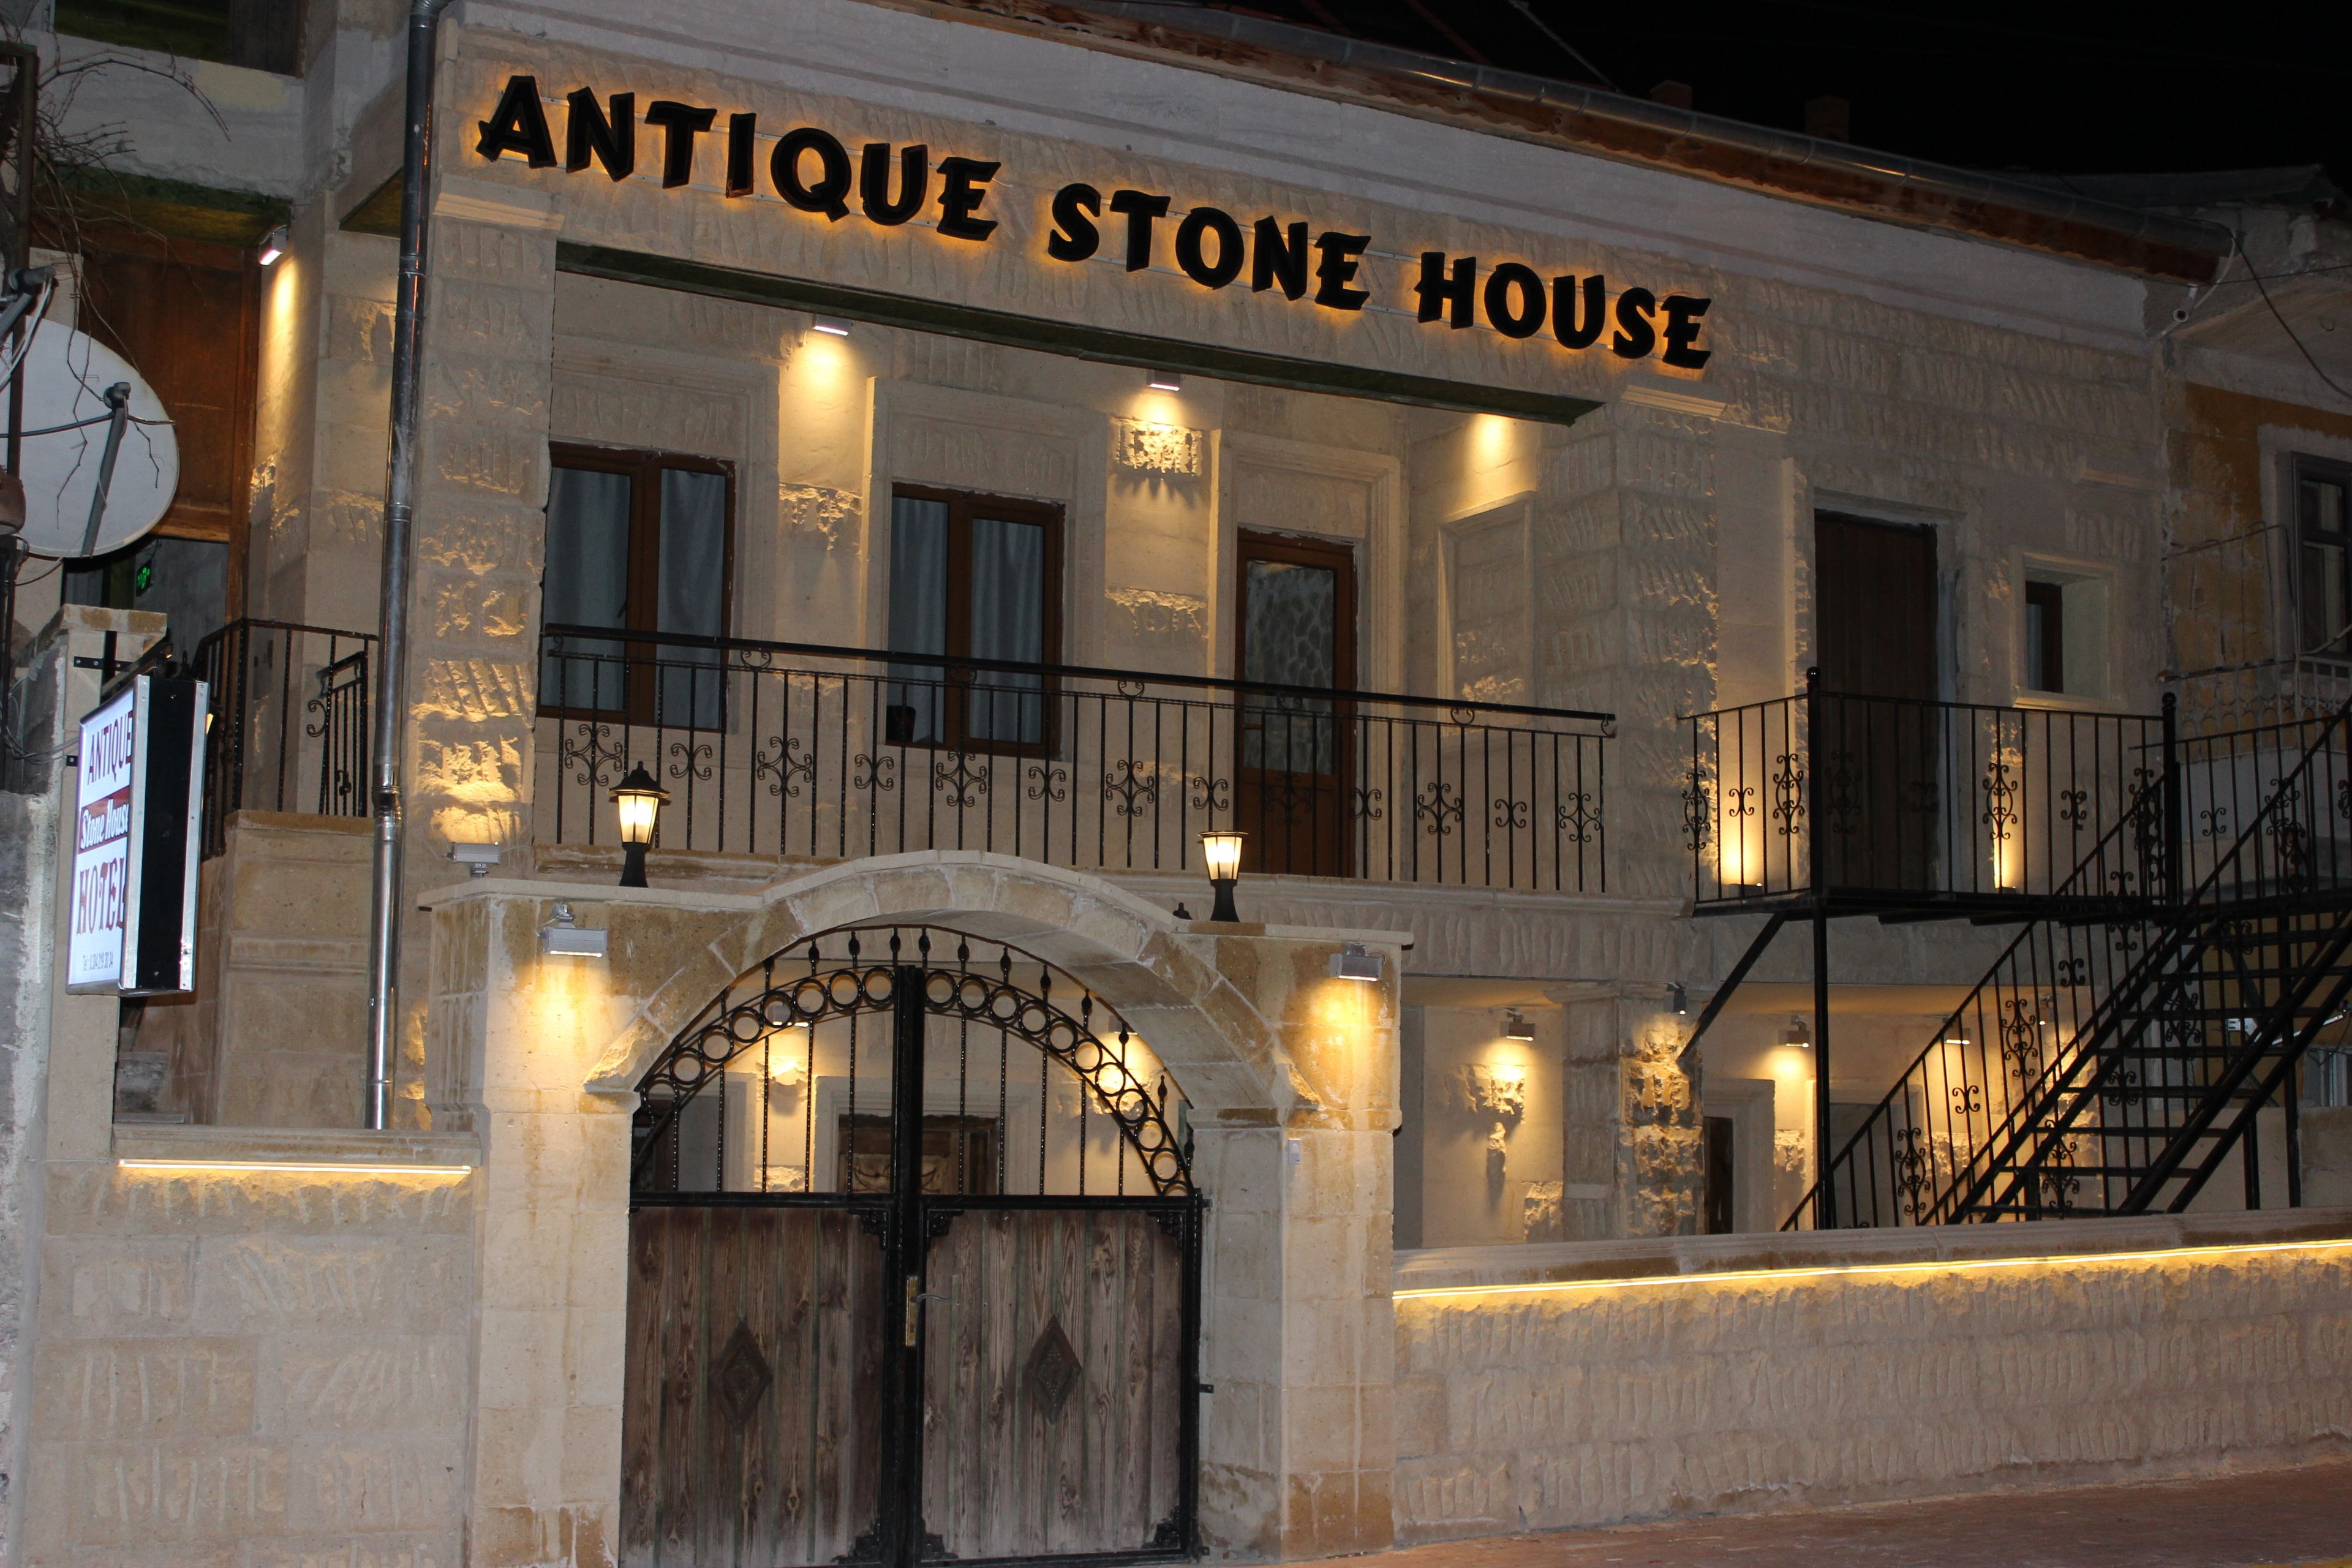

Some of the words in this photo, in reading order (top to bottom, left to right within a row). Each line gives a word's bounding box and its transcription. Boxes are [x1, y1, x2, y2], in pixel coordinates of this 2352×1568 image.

[475, 75, 1001, 241] ANTIQUE
[1048, 183, 1371, 311] STONE
[1414, 251, 1711, 369] HOUSE
[89, 710, 133, 783] ANTIQUE
[81, 809, 104, 850] Stone
[77, 858, 124, 935] HOTEL
